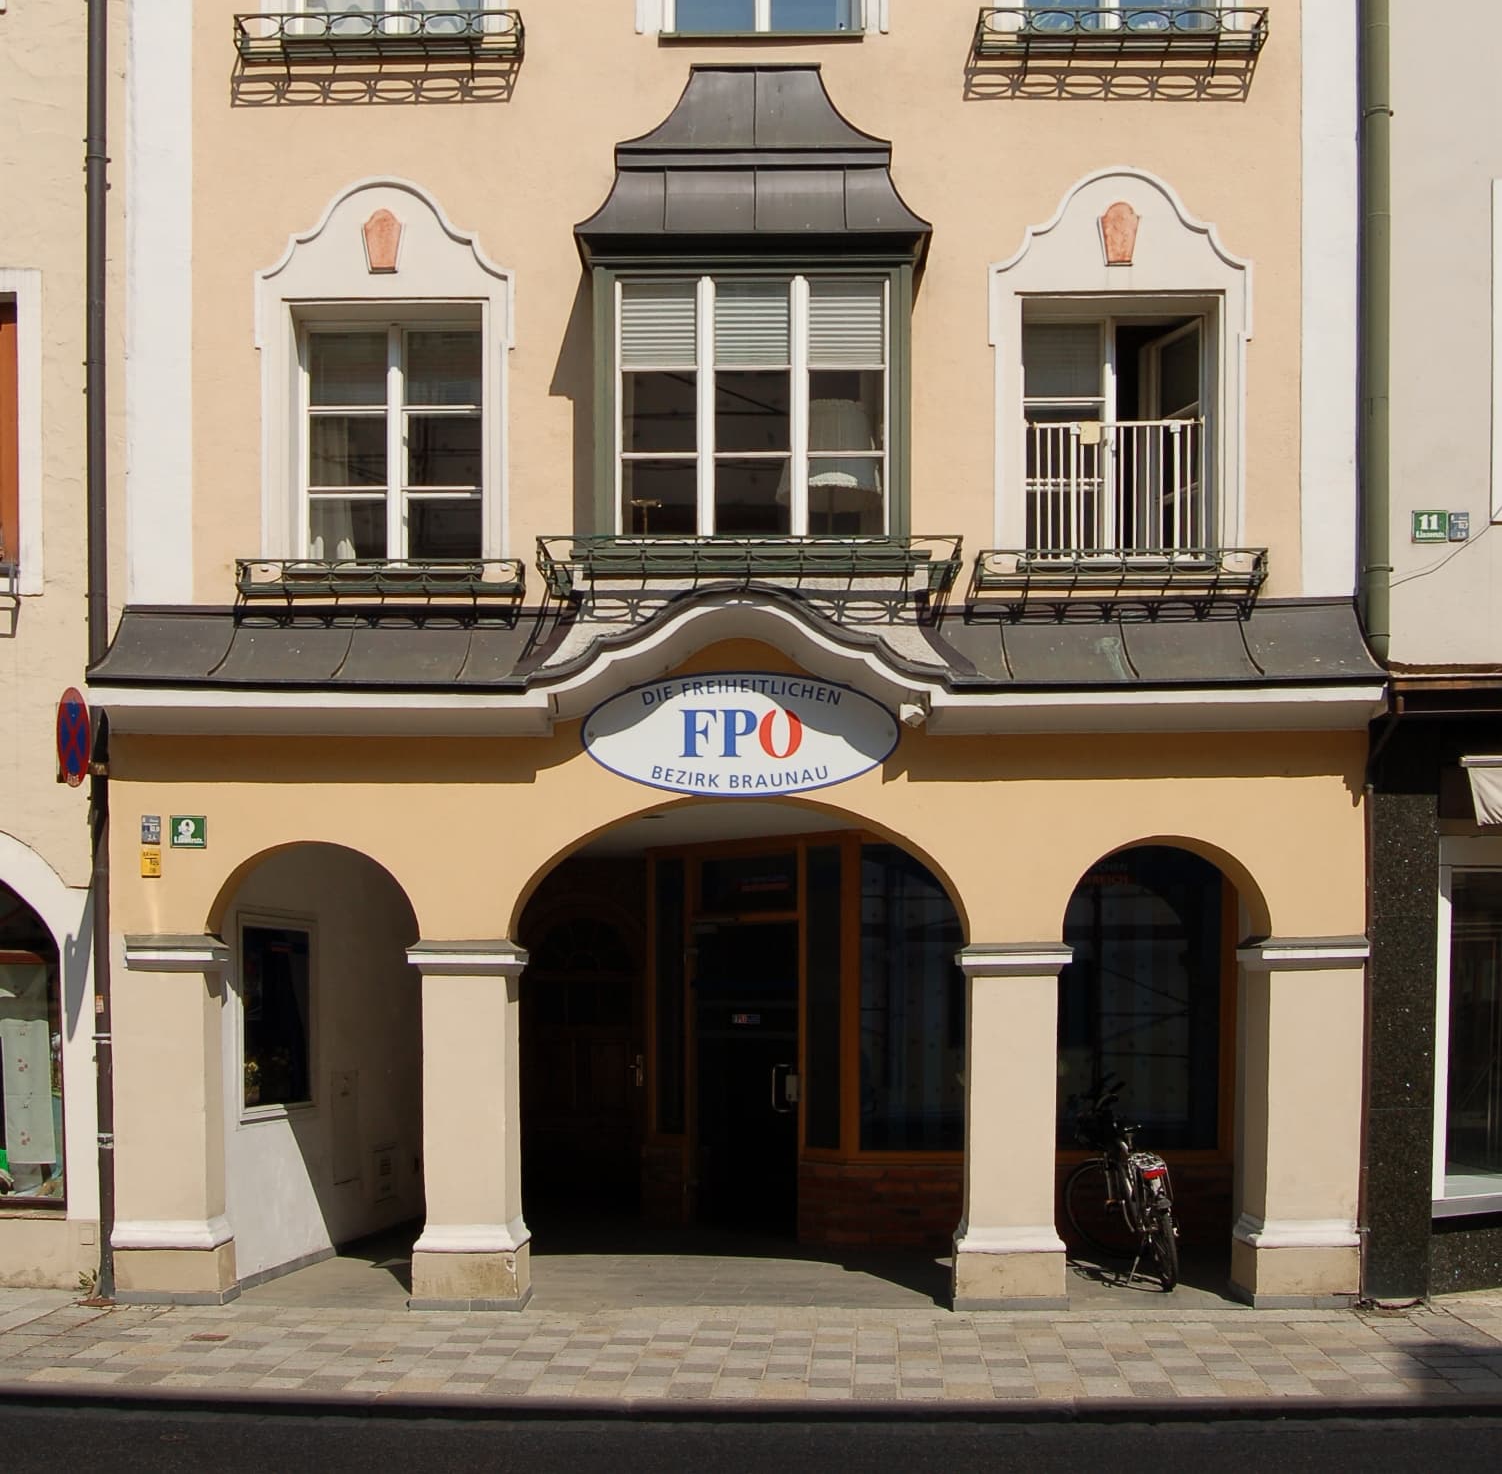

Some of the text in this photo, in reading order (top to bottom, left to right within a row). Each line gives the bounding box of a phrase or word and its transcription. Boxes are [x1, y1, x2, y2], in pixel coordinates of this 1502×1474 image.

[1418, 514, 1440, 530] 11
[641, 679, 842, 706] DIE FREIHEITLICHEN
[651, 765, 829, 788] BEZIRK BRAUNAU
